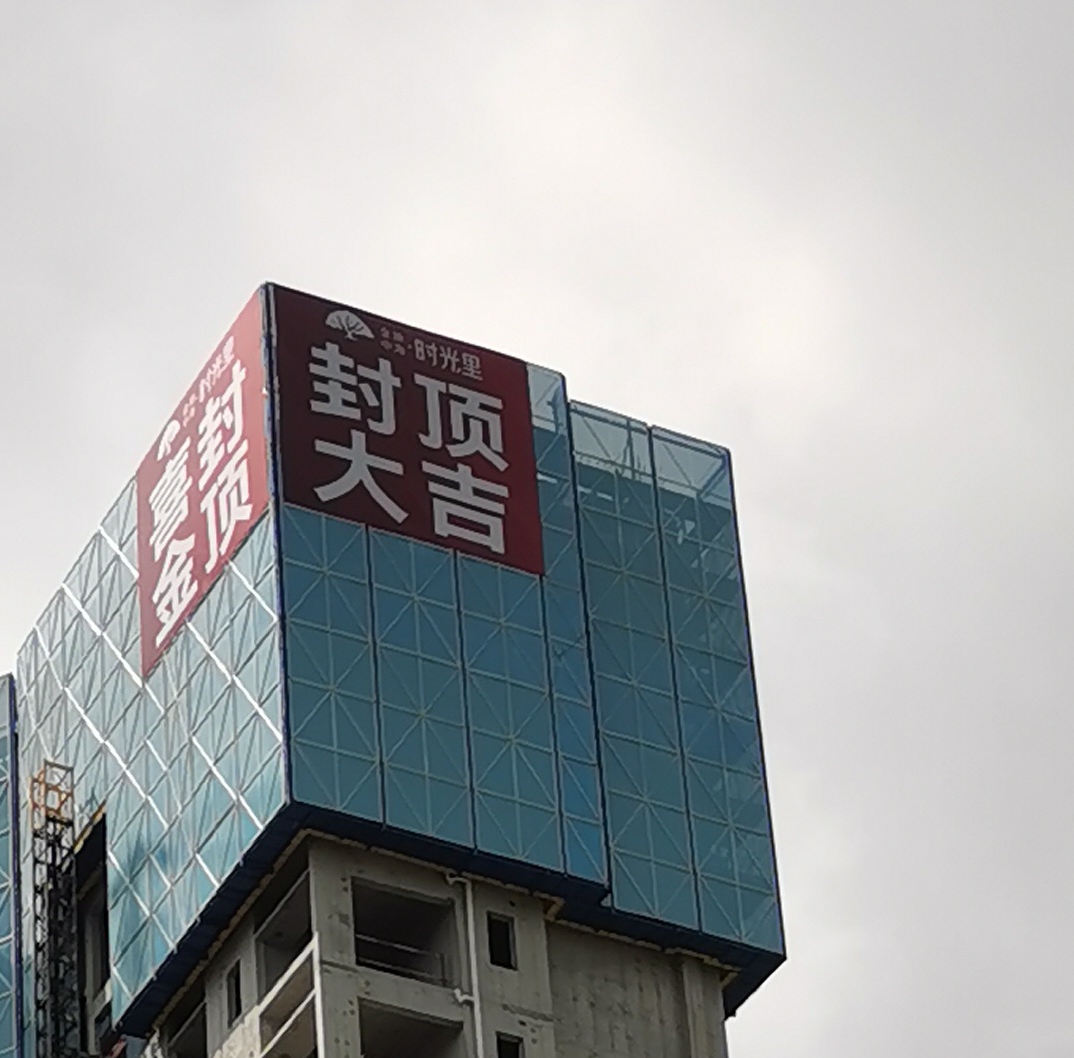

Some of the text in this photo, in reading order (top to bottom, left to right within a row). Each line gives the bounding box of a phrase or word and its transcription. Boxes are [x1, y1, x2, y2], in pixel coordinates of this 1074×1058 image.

[309, 342, 508, 472] 封顶
[414, 338, 483, 380] 时光里
[314, 431, 509, 555] 大吉
